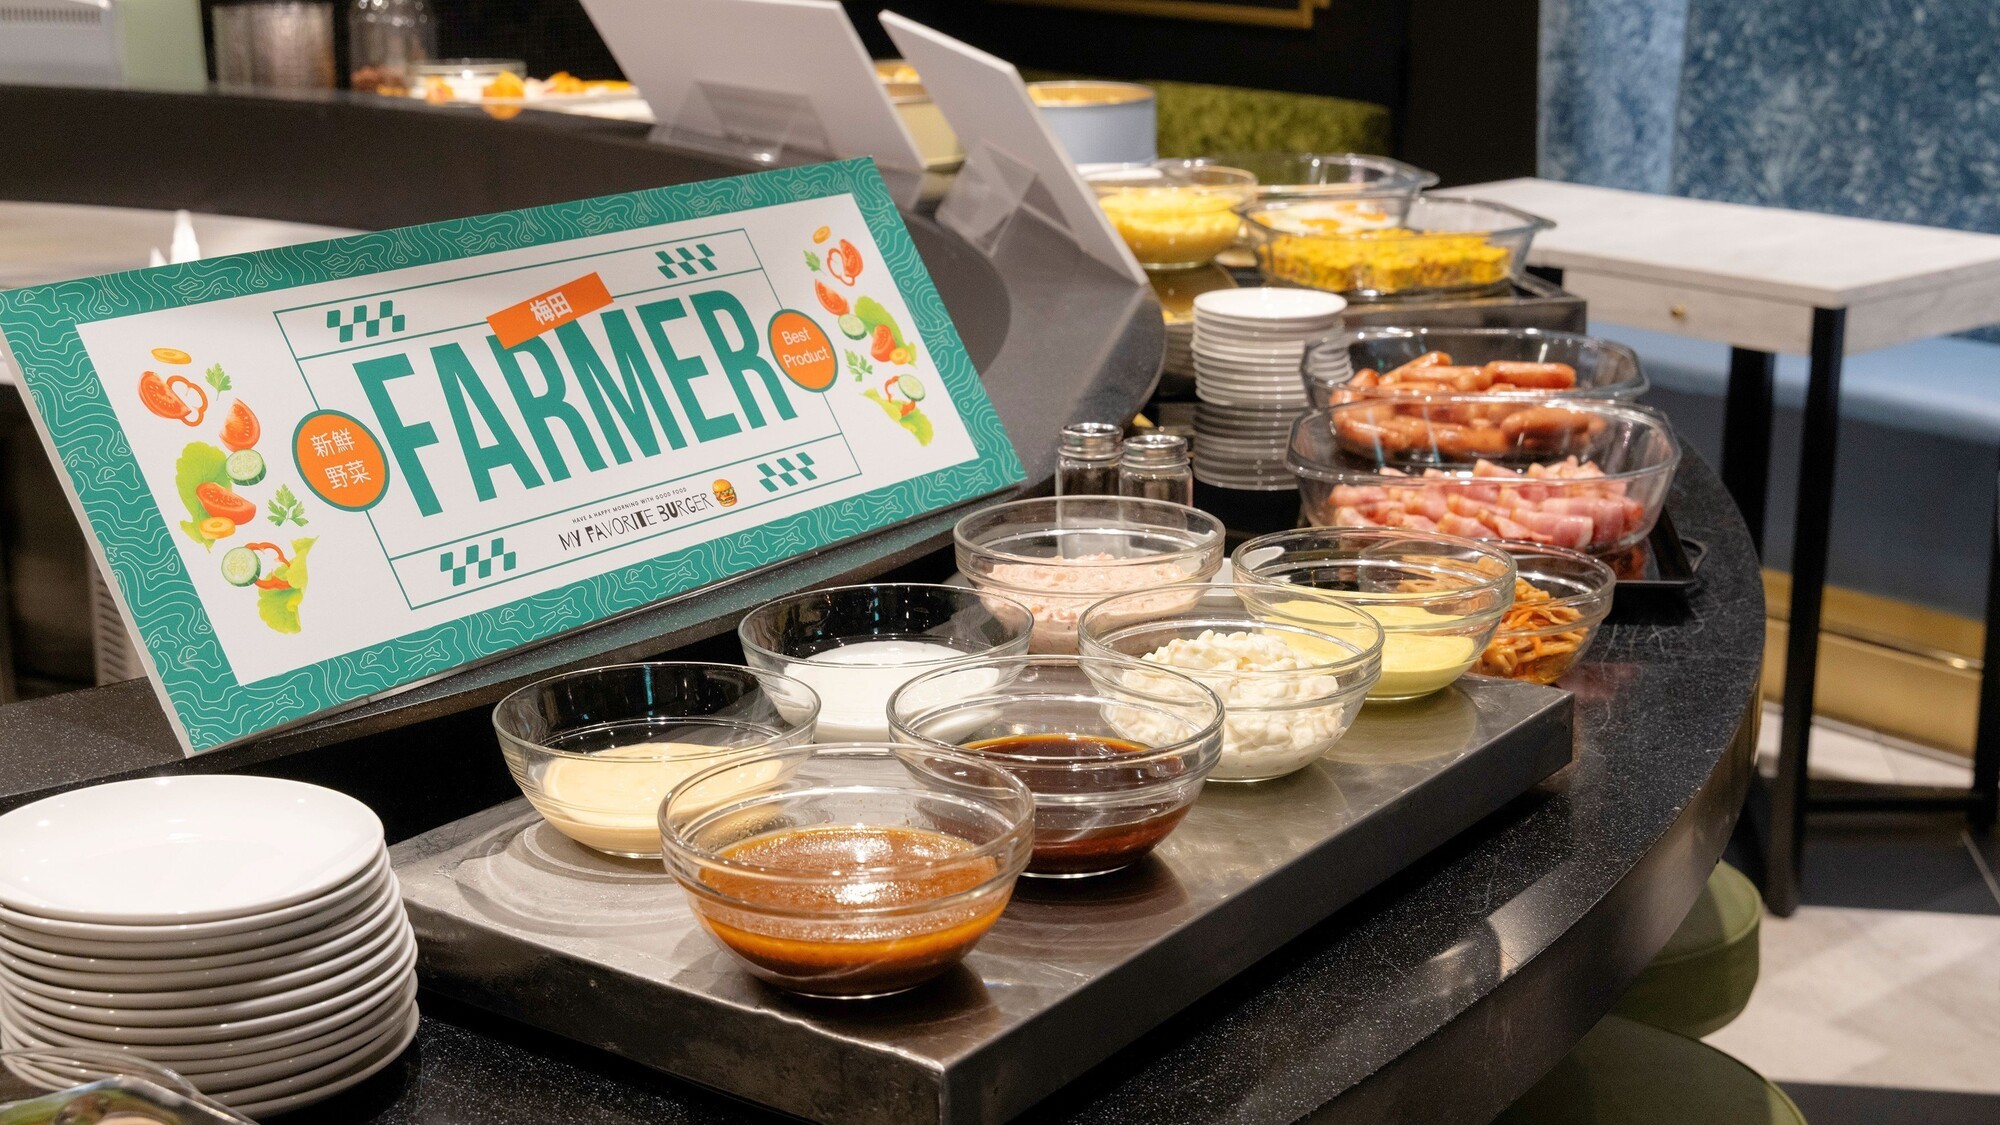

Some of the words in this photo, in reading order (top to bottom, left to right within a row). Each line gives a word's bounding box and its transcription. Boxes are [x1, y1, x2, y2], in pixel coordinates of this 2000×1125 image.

[529, 291, 573, 325] 梅田
[781, 327, 811, 346] Best
[782, 346, 830, 368] Product
[352, 290, 798, 518] FARMER
[310, 427, 355, 457] 新鮮
[324, 459, 371, 489] 野菜
[572, 515, 587, 523] HAVE
[593, 508, 611, 517] HAPPY
[612, 500, 639, 512] MORNING
[640, 496, 654, 504] WITH
[655, 491, 671, 500] GOOD
[672, 487, 687, 495] FOOD
[558, 529, 582, 551] MY
[584, 508, 657, 543] FAVORITE
[656, 492, 714, 522] BURGER
